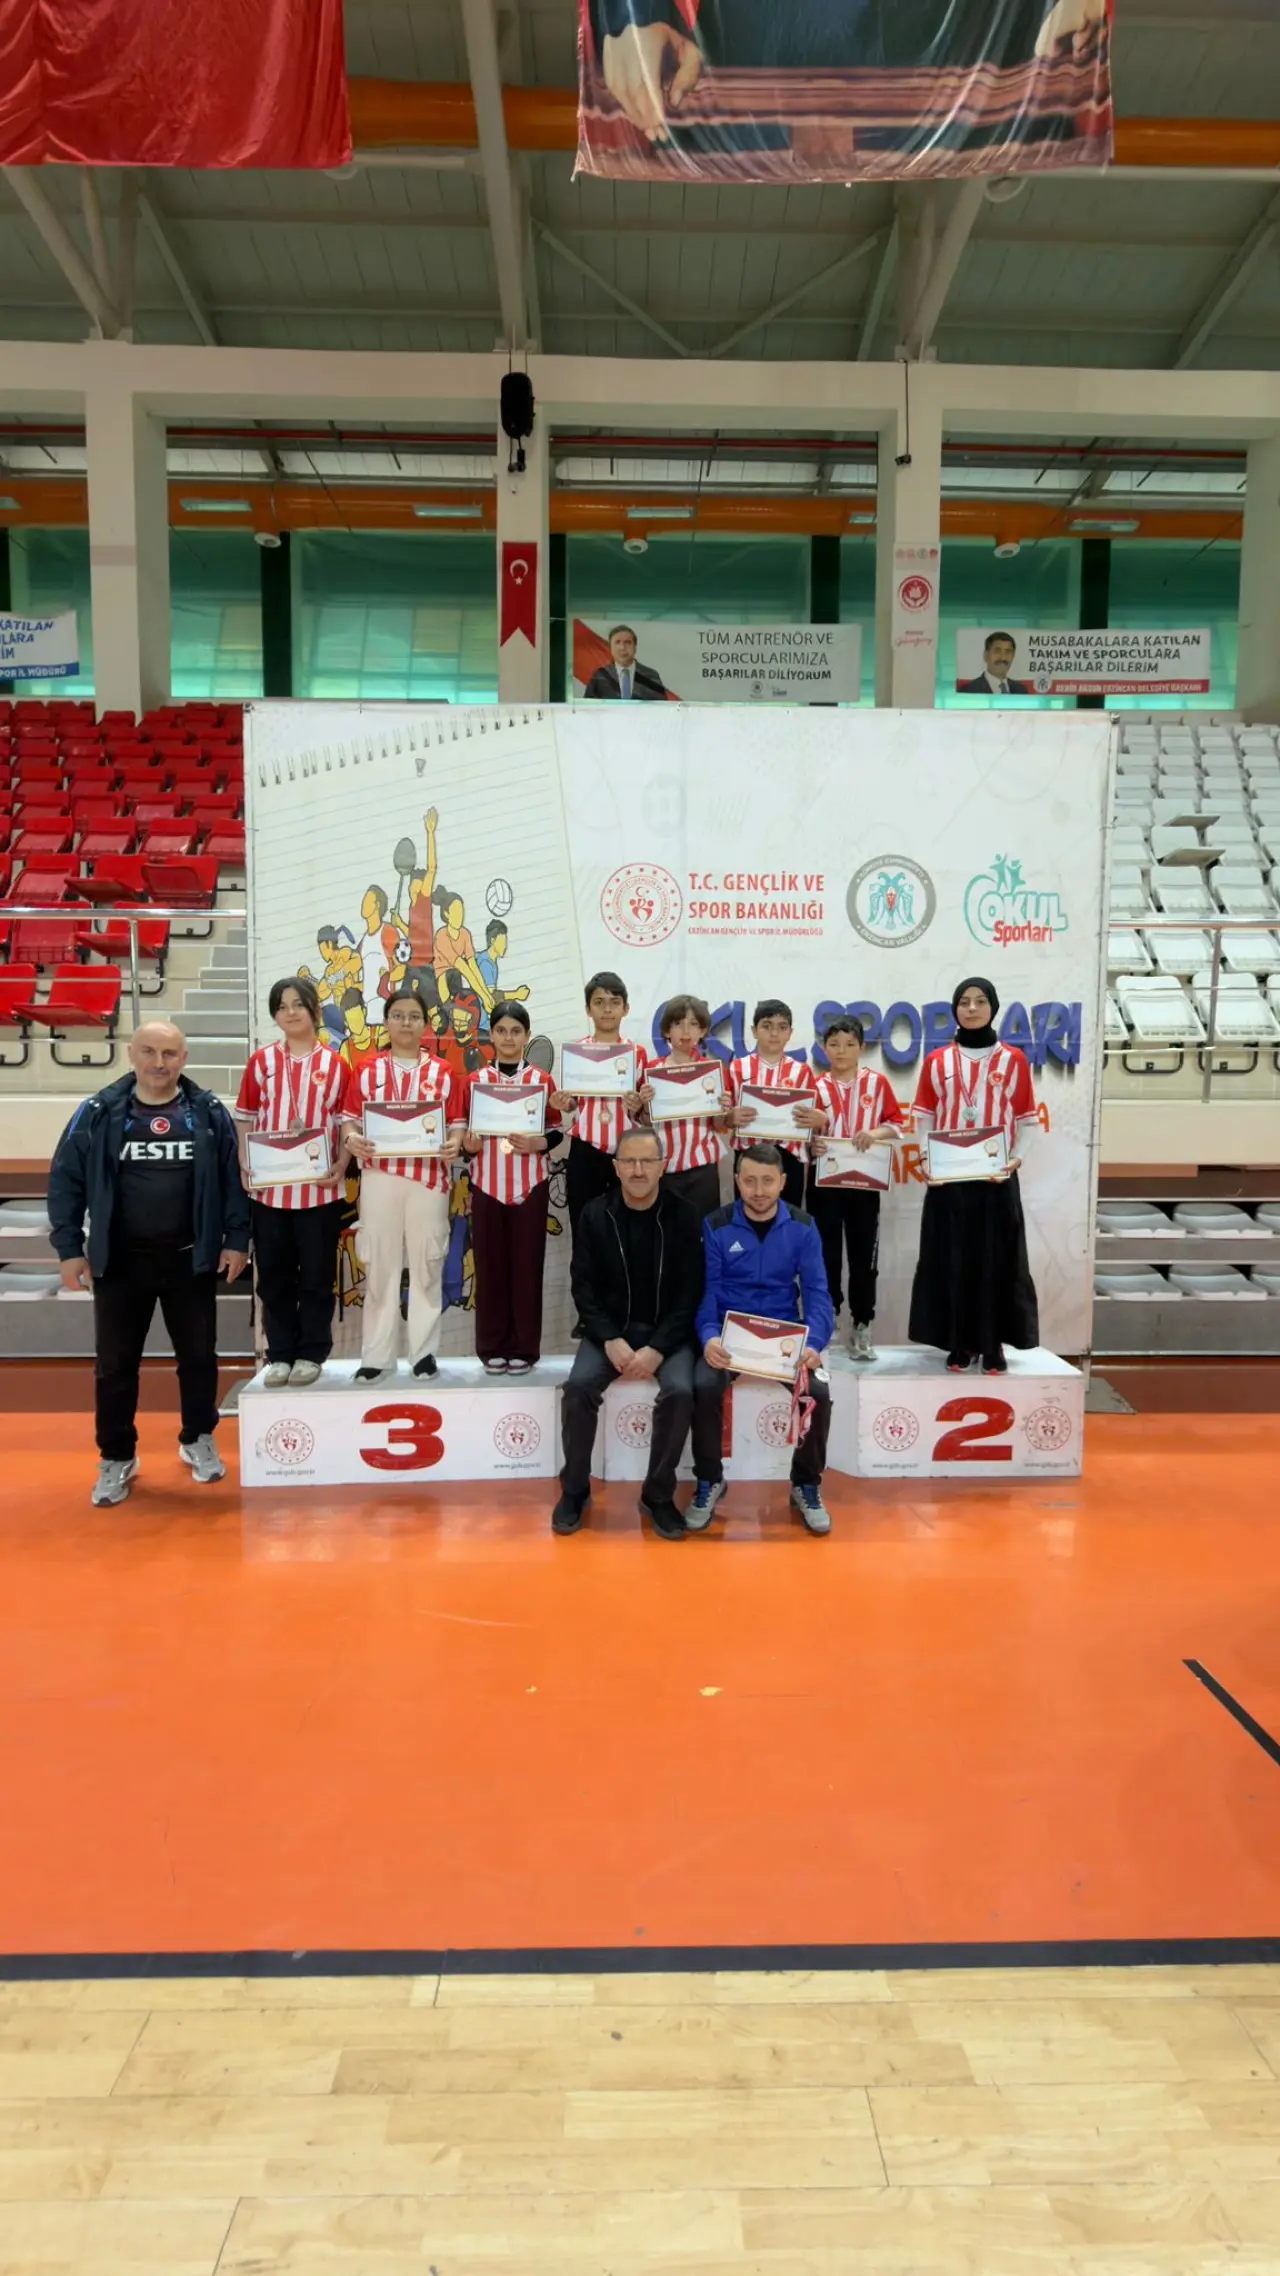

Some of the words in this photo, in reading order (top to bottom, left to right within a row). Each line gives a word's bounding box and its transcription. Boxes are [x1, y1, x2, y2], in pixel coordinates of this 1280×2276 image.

[0, 632, 35, 645] LARA
[699, 630, 730, 645] TÜM
[734, 631, 813, 645] ANTRENÖR
[816, 631, 834, 645] VE
[1144, 633, 1201, 646] KATILAN
[701, 651, 829, 666] SPORCULARIMIZA
[1028, 648, 1071, 659] TAKIM
[1073, 649, 1090, 660] VE
[1093, 648, 1181, 660] SPORCULARA
[702, 668, 766, 681] BAŞARILAR
[768, 668, 832, 680] DİLİYORUM
[1028, 661, 1104, 675] BAŞARILAR
[688, 873, 719, 891] T.C.
[723, 870, 799, 896] GENÇLİK
[804, 874, 825, 892] VE
[688, 901, 731, 919] SPOR
[736, 899, 824, 920] BAKANLIĞI
[977, 890, 1069, 932] OKUL
[993, 919, 1053, 949] Sporları
[811, 1000, 1083, 1067] SPORARI
[119, 1141, 194, 1160] VESTE
[359, 1402, 445, 1471] 3
[931, 1396, 1015, 1462] 2
